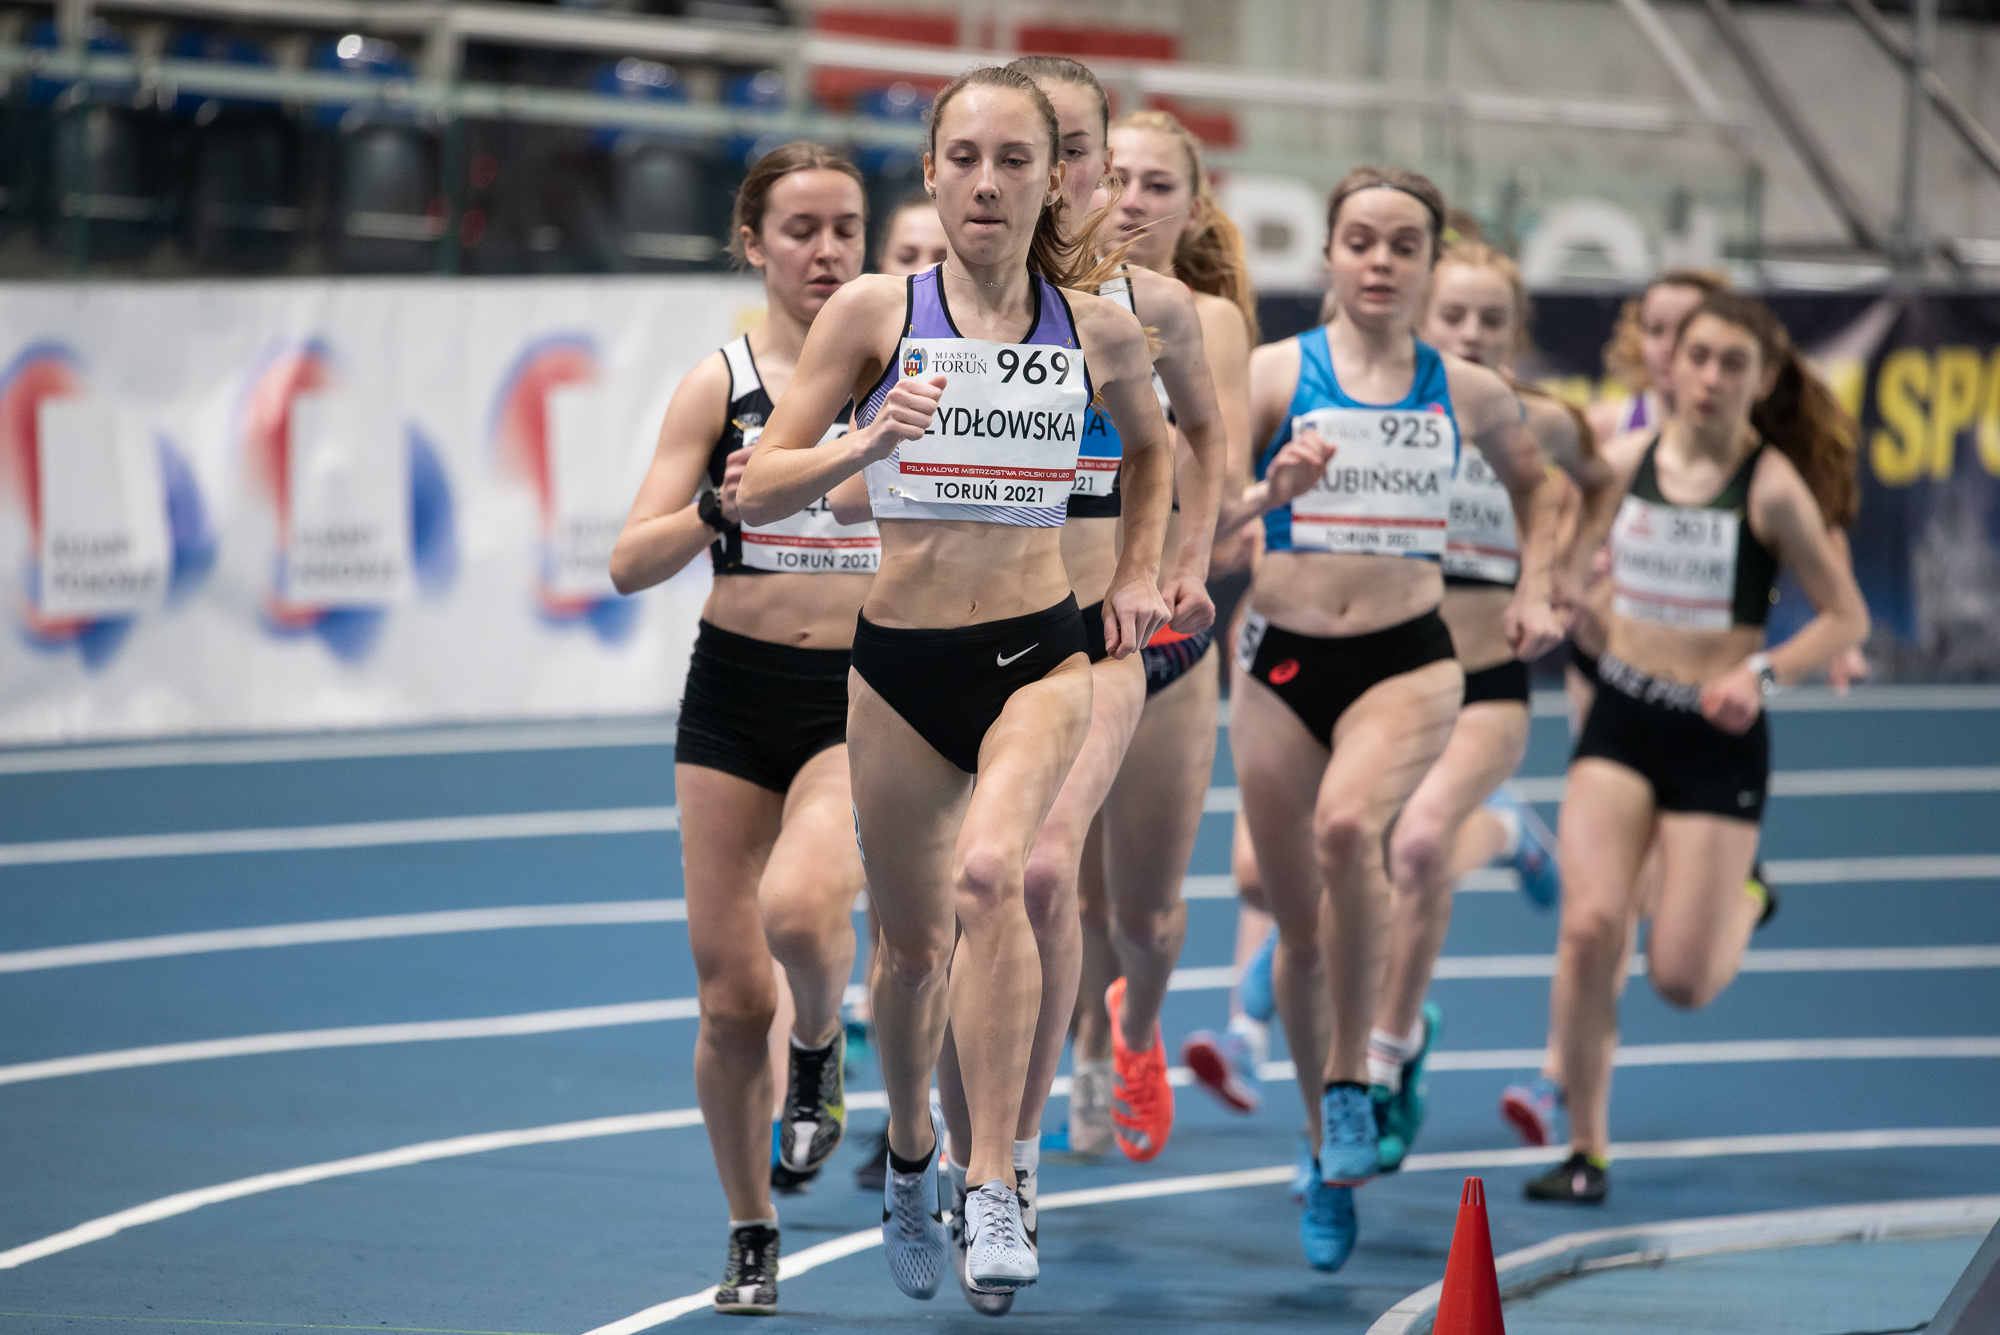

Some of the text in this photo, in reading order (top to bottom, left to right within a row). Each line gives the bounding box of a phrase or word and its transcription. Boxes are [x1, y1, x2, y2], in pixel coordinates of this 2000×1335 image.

[935, 352, 977, 360] MIASTO
[932, 359, 988, 375] TORUŃ
[996, 349, 1070, 386] 969
[1380, 416, 1441, 449] 925
[906, 465, 925, 473] PZLA
[926, 466, 960, 475] HALOWE
[961, 467, 1017, 477] MISTRZOSTWA
[1018, 470, 1046, 478] POLSKI
[1046, 471, 1058, 479] U18
[935, 480, 1044, 503] TORUŃ 2021
[1071, 477, 1093, 491] 21
[776, 549, 878, 569] TORUŃ 2021
